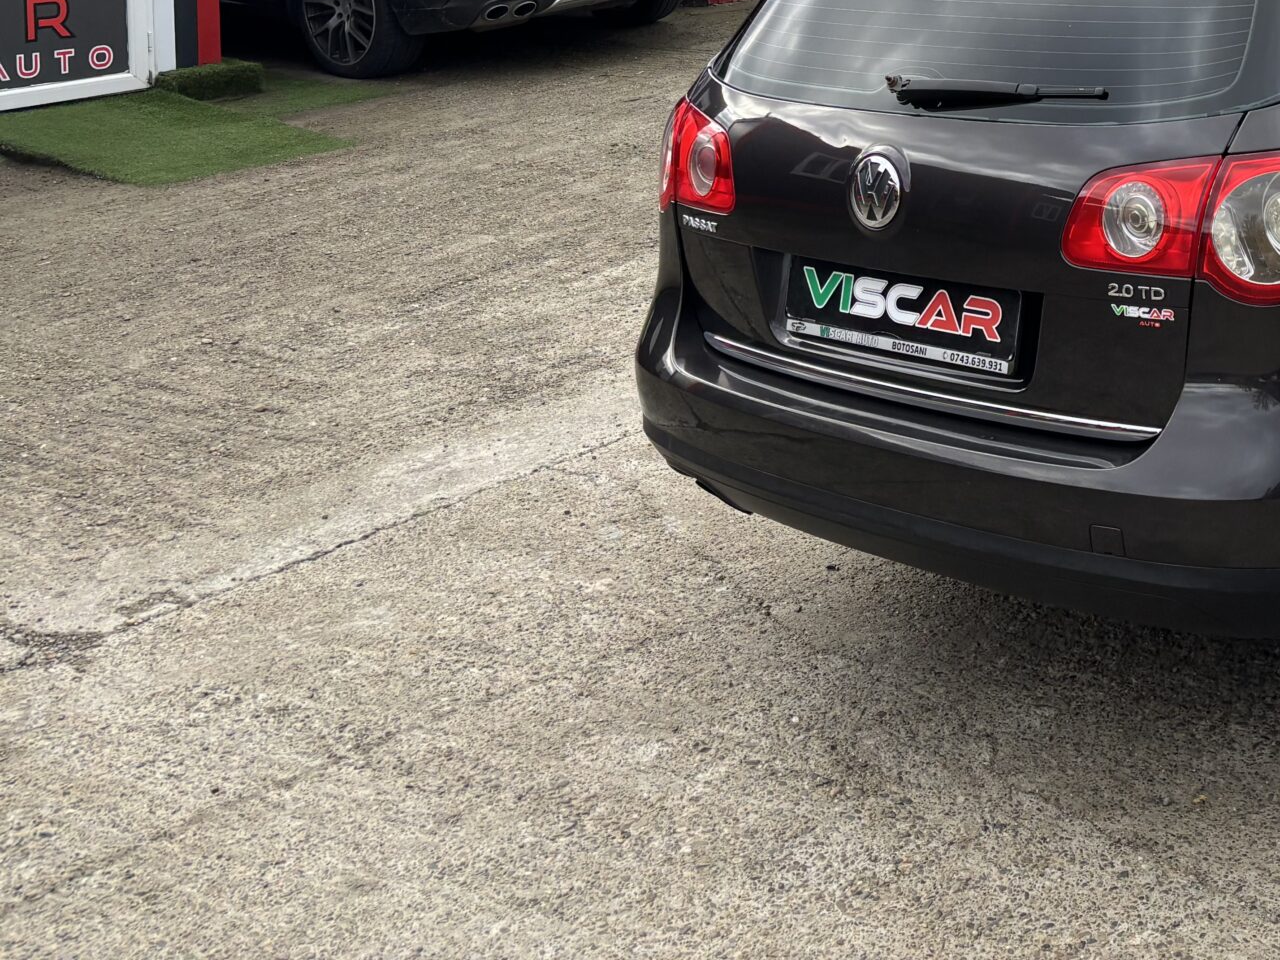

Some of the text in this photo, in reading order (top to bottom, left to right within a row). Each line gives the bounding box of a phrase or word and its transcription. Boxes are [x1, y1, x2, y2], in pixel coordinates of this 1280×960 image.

[682, 214, 718, 233] PASSAT
[1137, 286, 1165, 300] TD
[803, 266, 1003, 342] VISCAR
[1110, 303, 1175, 321] VISCAR
[820, 325, 1003, 372] VISCAR AUTO BOTOSANI 0743.639.931
